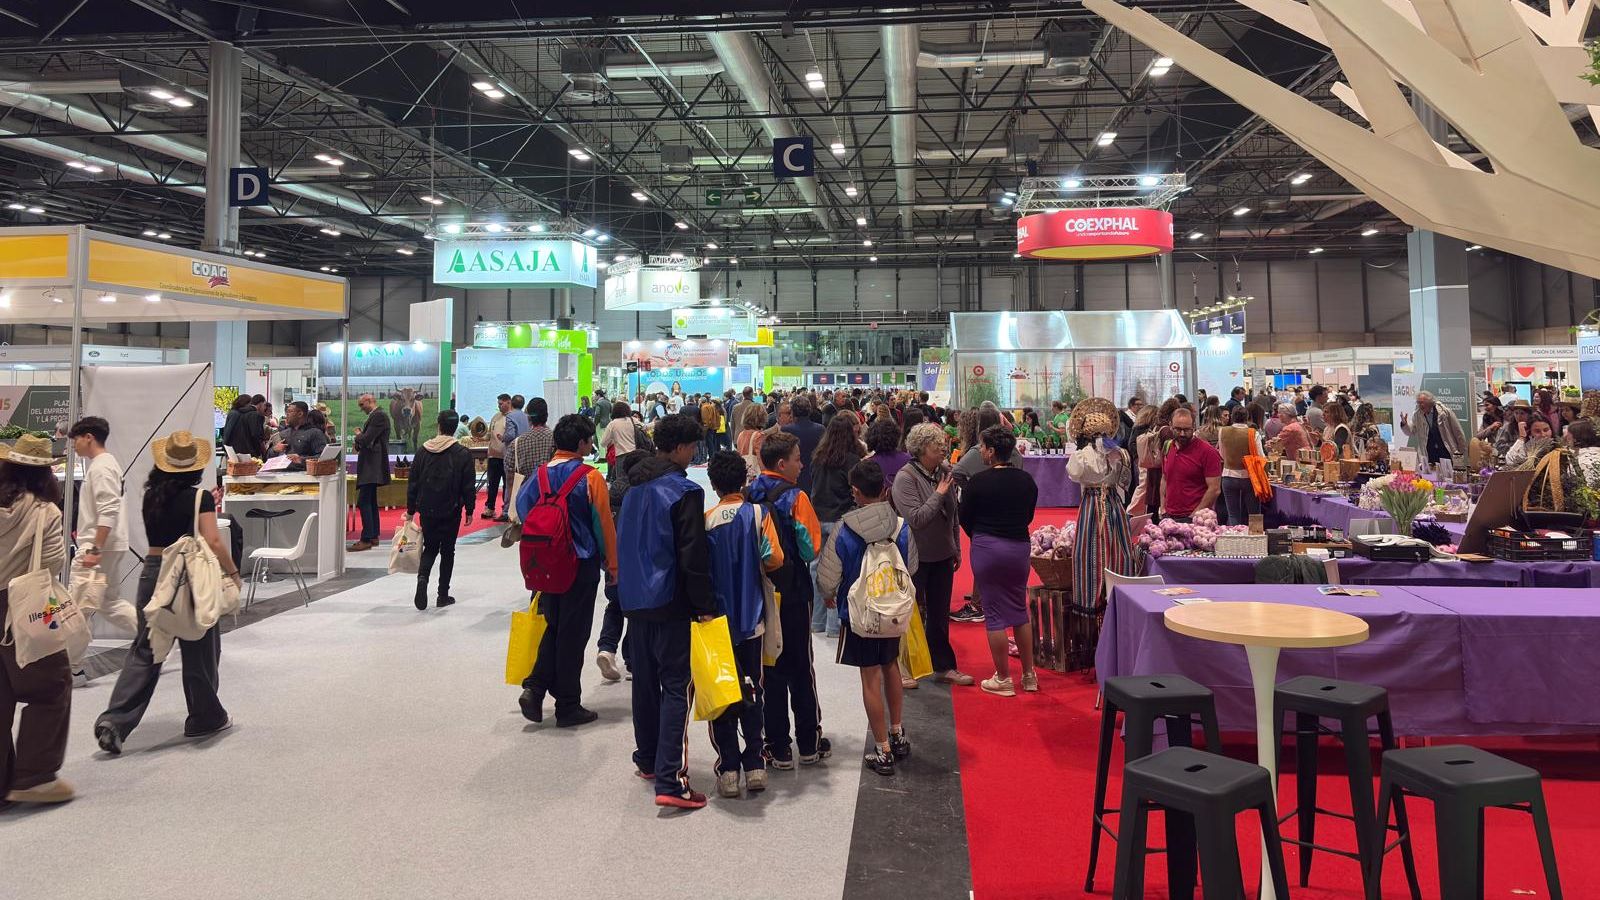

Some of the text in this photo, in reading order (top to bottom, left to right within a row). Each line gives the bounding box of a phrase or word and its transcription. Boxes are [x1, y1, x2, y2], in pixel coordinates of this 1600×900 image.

[783, 144, 805, 172] C
[237, 173, 261, 202] D
[1065, 217, 1139, 233] COEXPHAL
[469, 249, 561, 272] ASAJA
[193, 261, 228, 278] COAG
[651, 274, 690, 294] anove
[366, 347, 404, 357] ASAJA
[924, 367, 938, 375] del
[721, 509, 739, 521] GS
[29, 611, 48, 623] Illes
